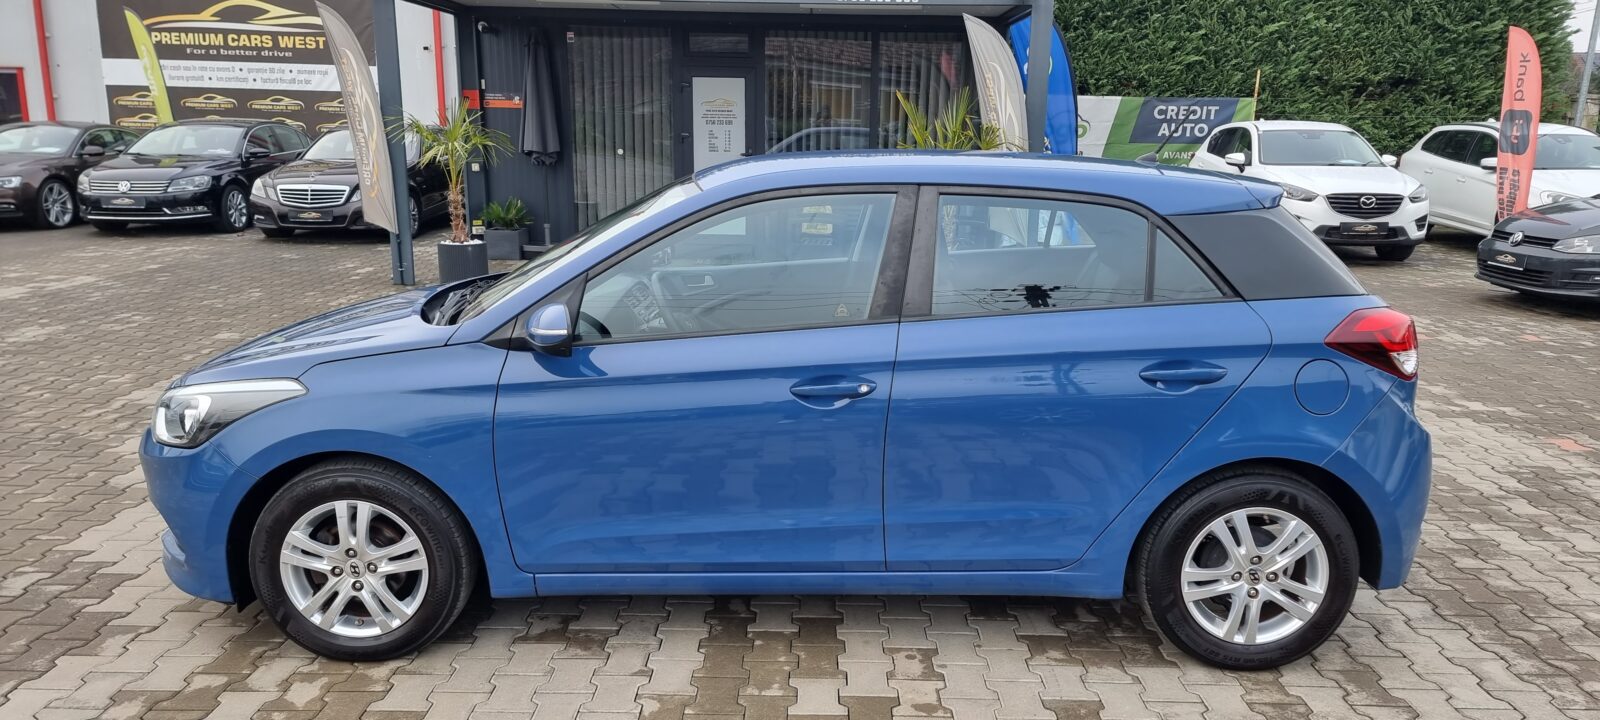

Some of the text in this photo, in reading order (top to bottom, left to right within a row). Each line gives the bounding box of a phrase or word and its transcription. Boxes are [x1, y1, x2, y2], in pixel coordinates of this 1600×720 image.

[150, 31, 326, 50] PREMIUM CARS WEST
[186, 47, 207, 55] For
[220, 48, 257, 56] better
[261, 49, 293, 57] drive
[1513, 52, 1531, 101] bank
[1153, 105, 1220, 120] CREDIT
[1157, 122, 1209, 138] AUTO
